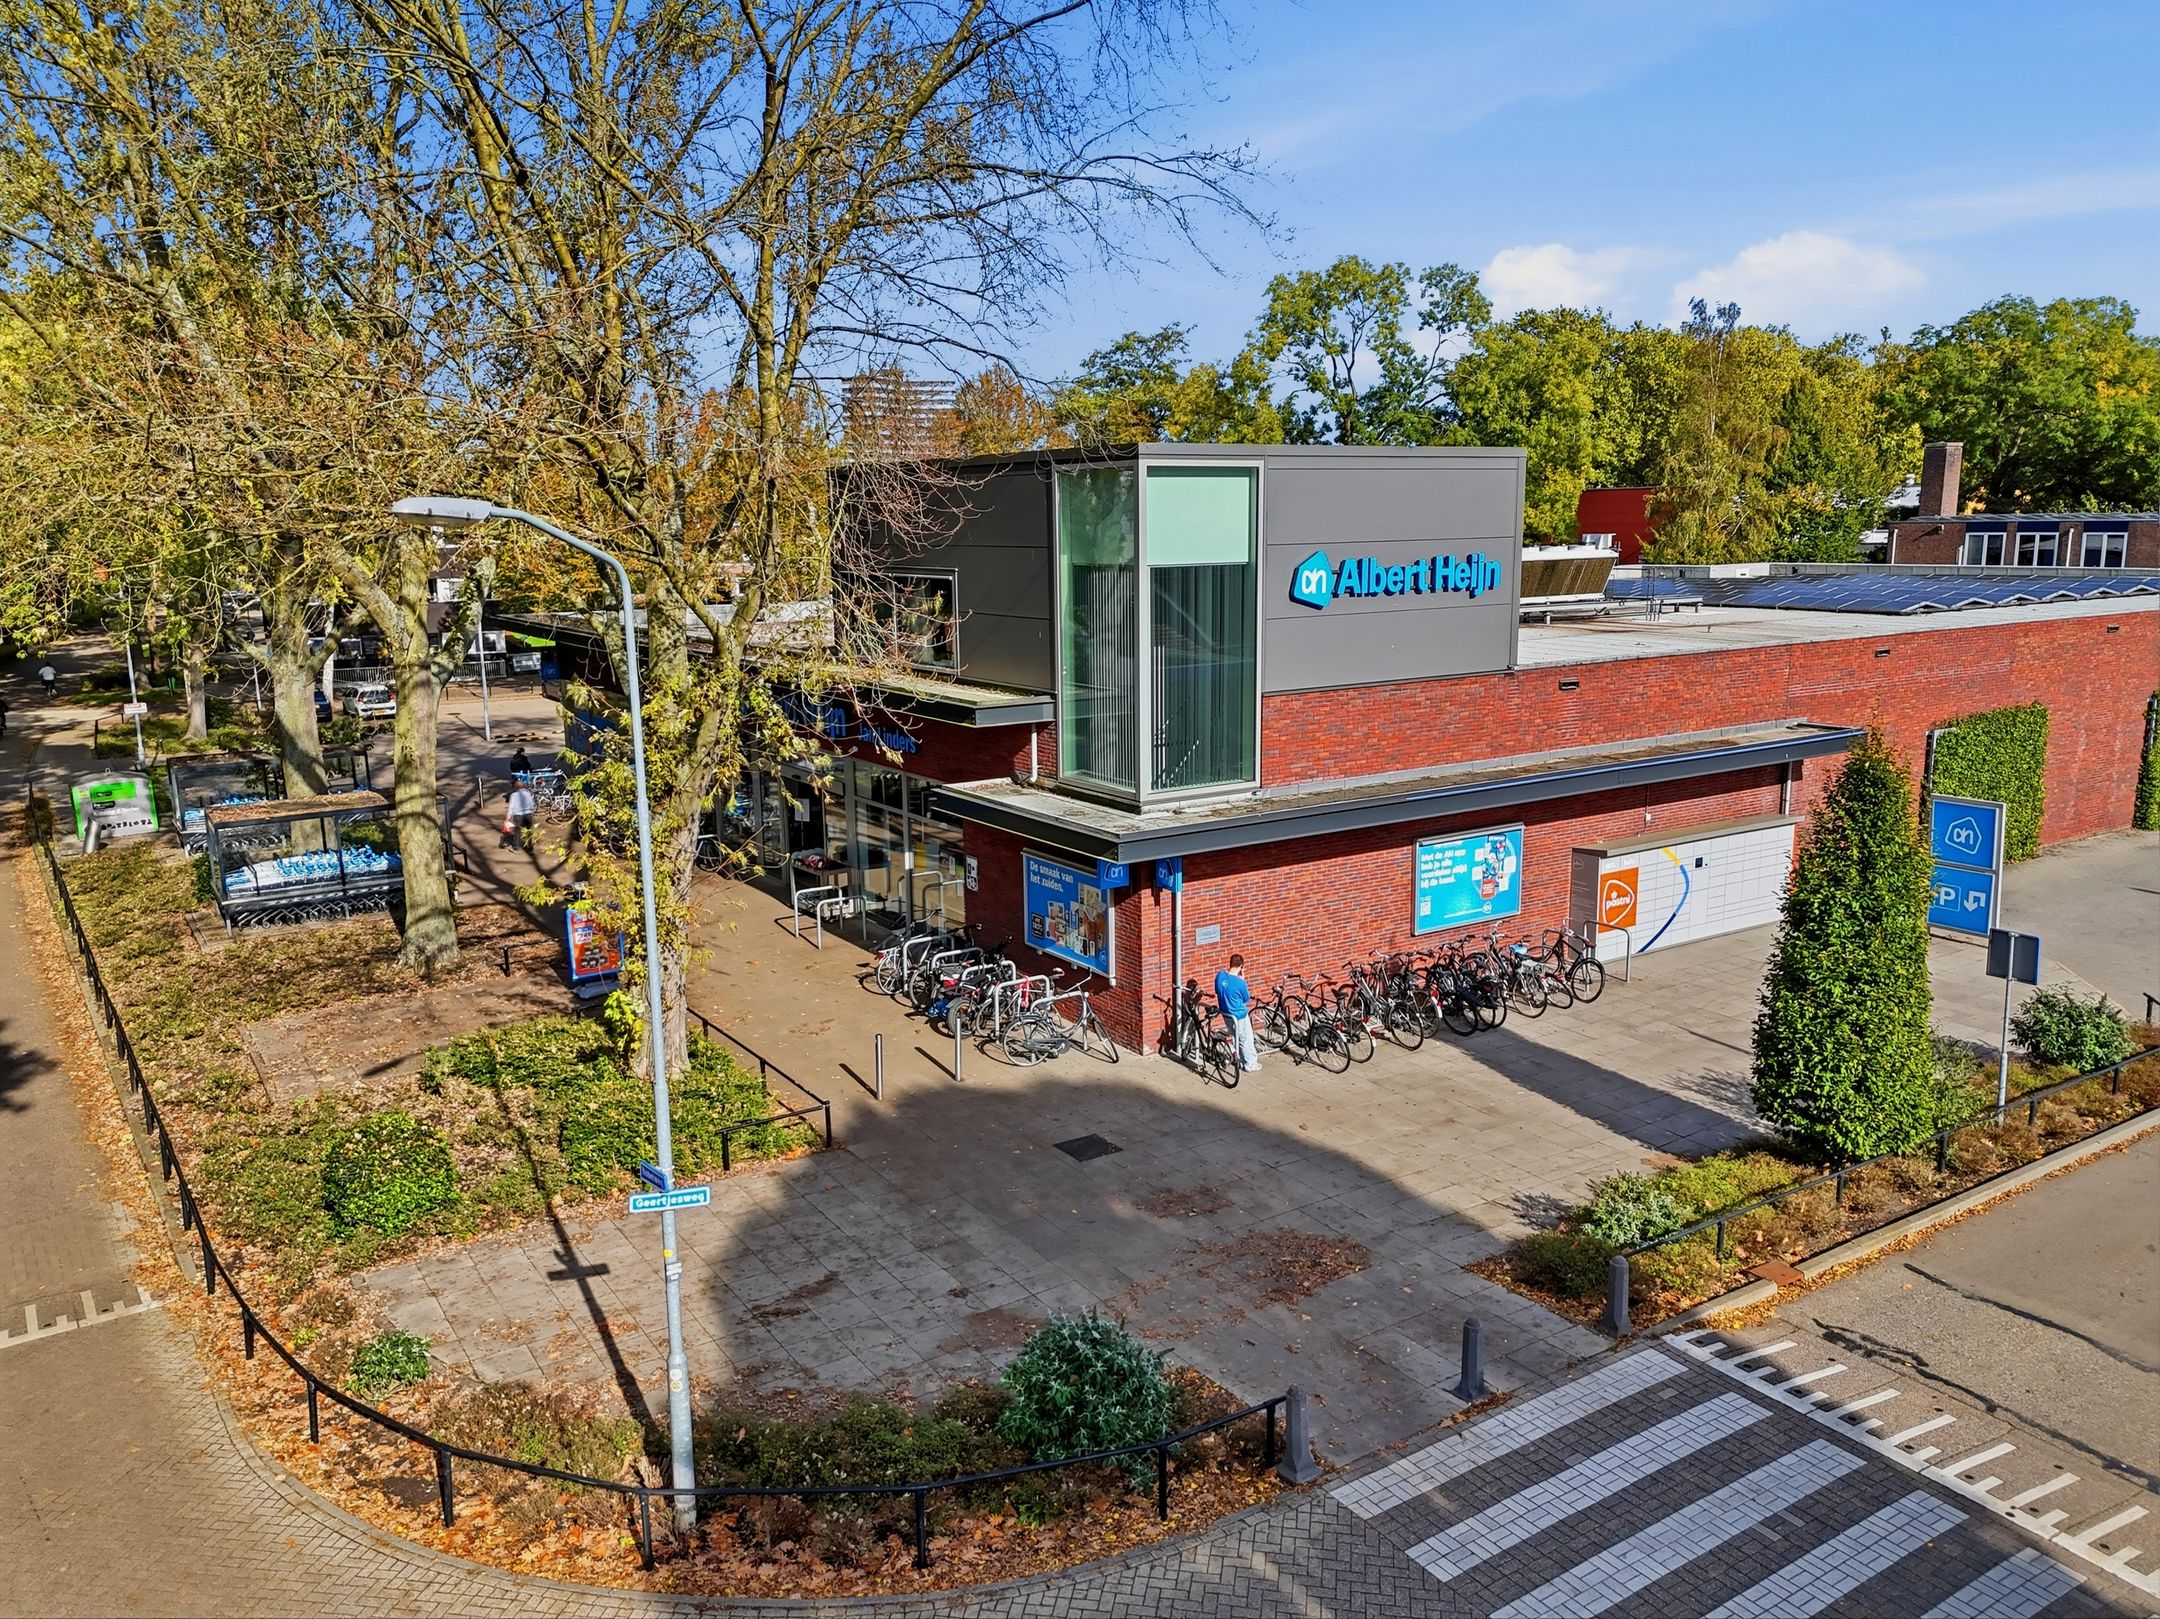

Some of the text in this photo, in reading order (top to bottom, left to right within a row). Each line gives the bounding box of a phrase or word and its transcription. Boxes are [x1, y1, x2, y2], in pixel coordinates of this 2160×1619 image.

[1337, 552, 1502, 598] Albert Heijn
[1030, 861, 1074, 884] De smaak van
[1030, 872, 1041, 885] het
[1939, 887, 1956, 906] P
[635, 1193, 704, 1208] Geertjesweg
